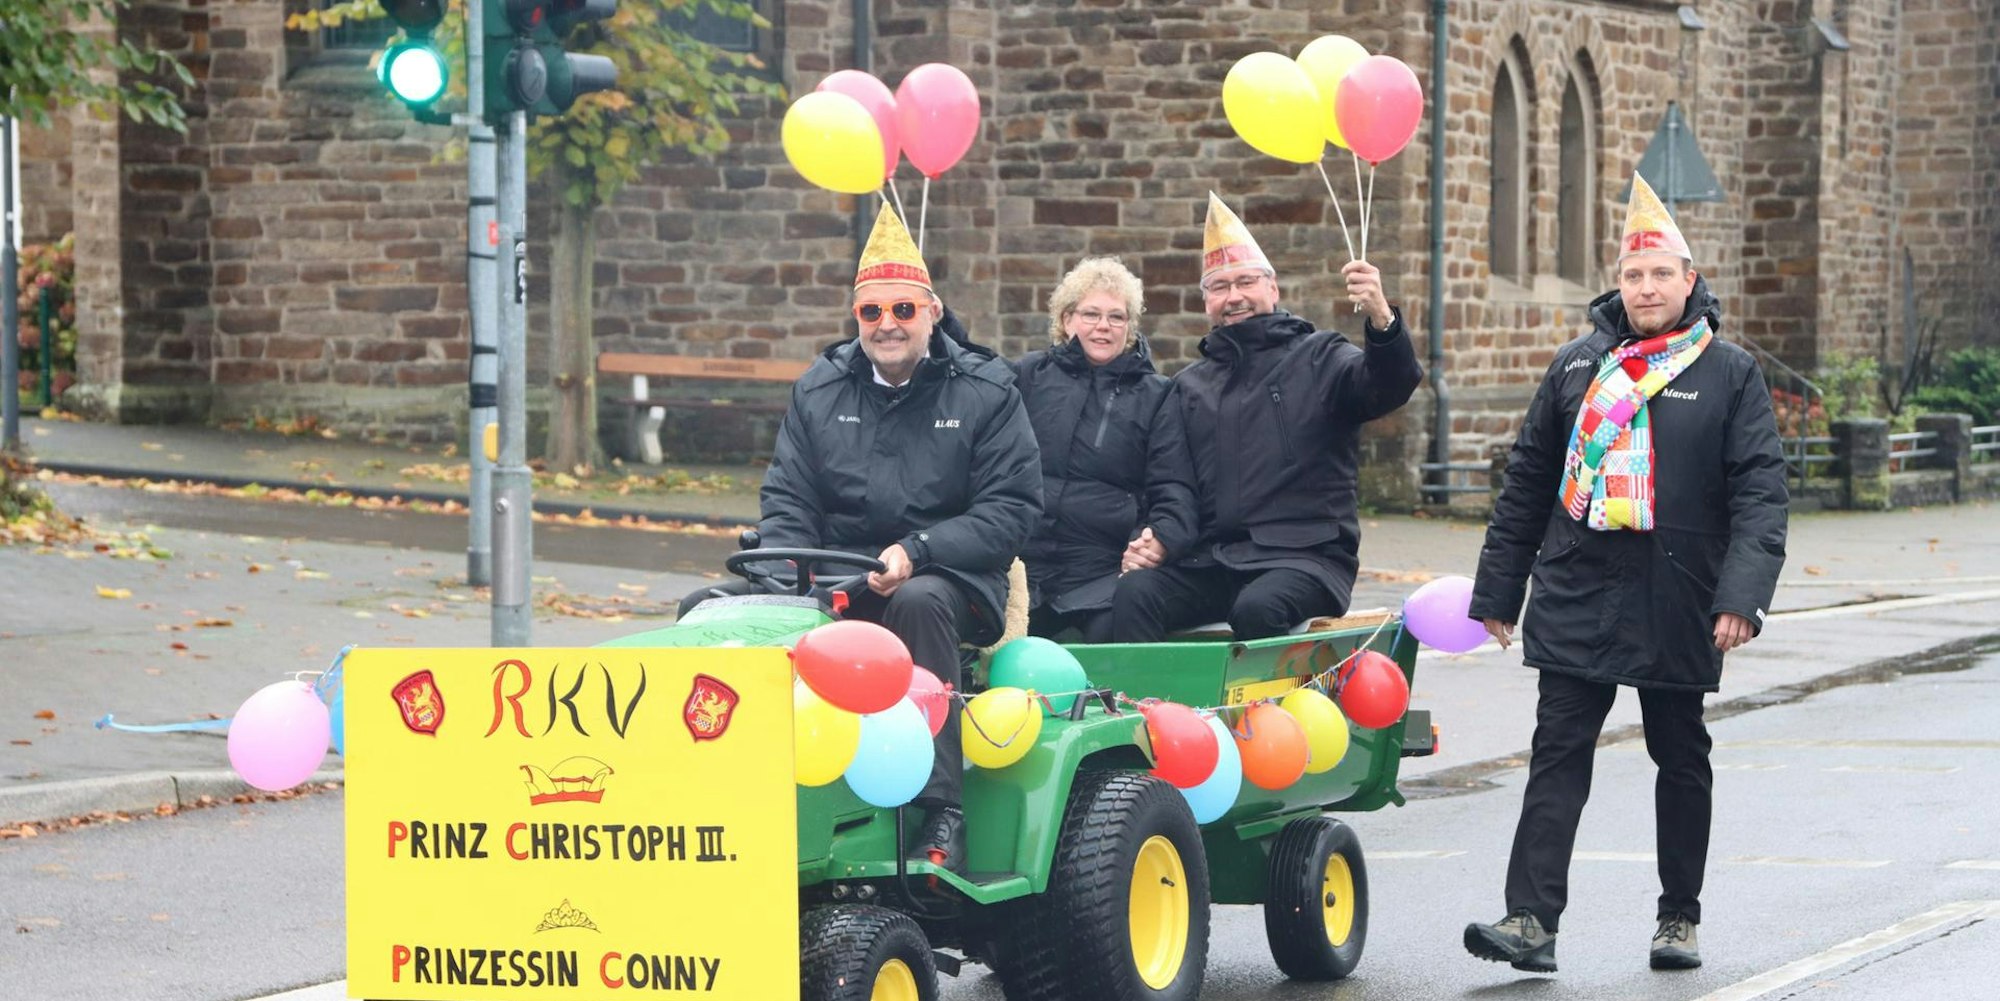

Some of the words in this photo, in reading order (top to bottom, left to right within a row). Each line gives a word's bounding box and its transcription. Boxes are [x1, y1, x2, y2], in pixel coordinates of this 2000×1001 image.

[1661, 388, 1699, 400] Marcel
[934, 419, 960, 428] KLAUS
[484, 659, 647, 739] RKV
[388, 820, 488, 859] PRINZ
[505, 822, 686, 861] CHRISTOPH
[695, 825, 737, 862] III.
[392, 944, 579, 988] PRINZESSIN
[599, 951, 721, 992] CONNY
